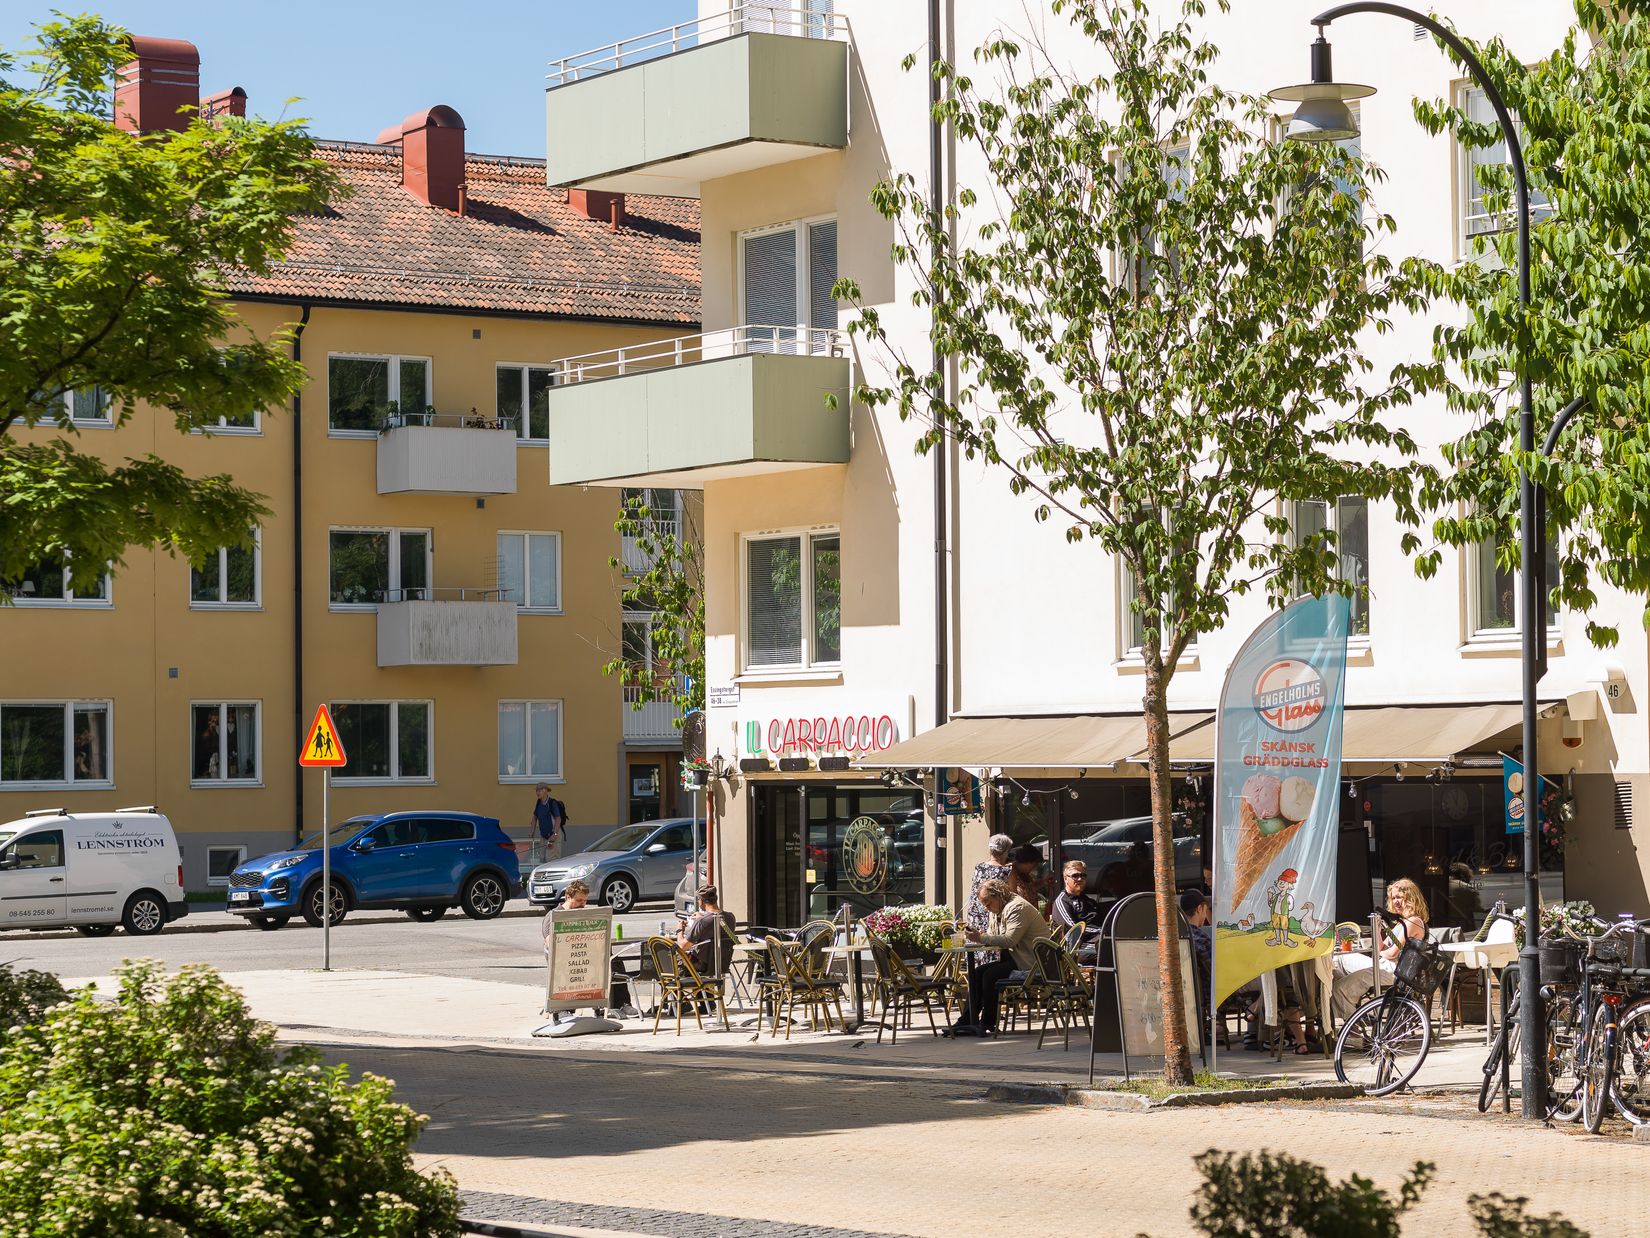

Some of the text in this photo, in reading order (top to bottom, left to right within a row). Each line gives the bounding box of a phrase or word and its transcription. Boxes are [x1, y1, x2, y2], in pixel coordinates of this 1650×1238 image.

[1260, 682, 1321, 708] ENGELHOLMS
[1608, 684, 1619, 697] 46
[747, 715, 893, 753] IL CARPACCIO
[1261, 740, 1316, 753] SKÅNSK
[1243, 754, 1329, 768] GRÄDDGLASS
[850, 818, 885, 853] CARPACO
[77, 837, 165, 850] LENNSTRÖM
[9, 909, 31, 917] 08-545
[565, 932, 605, 942] CARPACCIO
[568, 959, 590, 967] SALLAD
[569, 967, 588, 975] KEBAB
